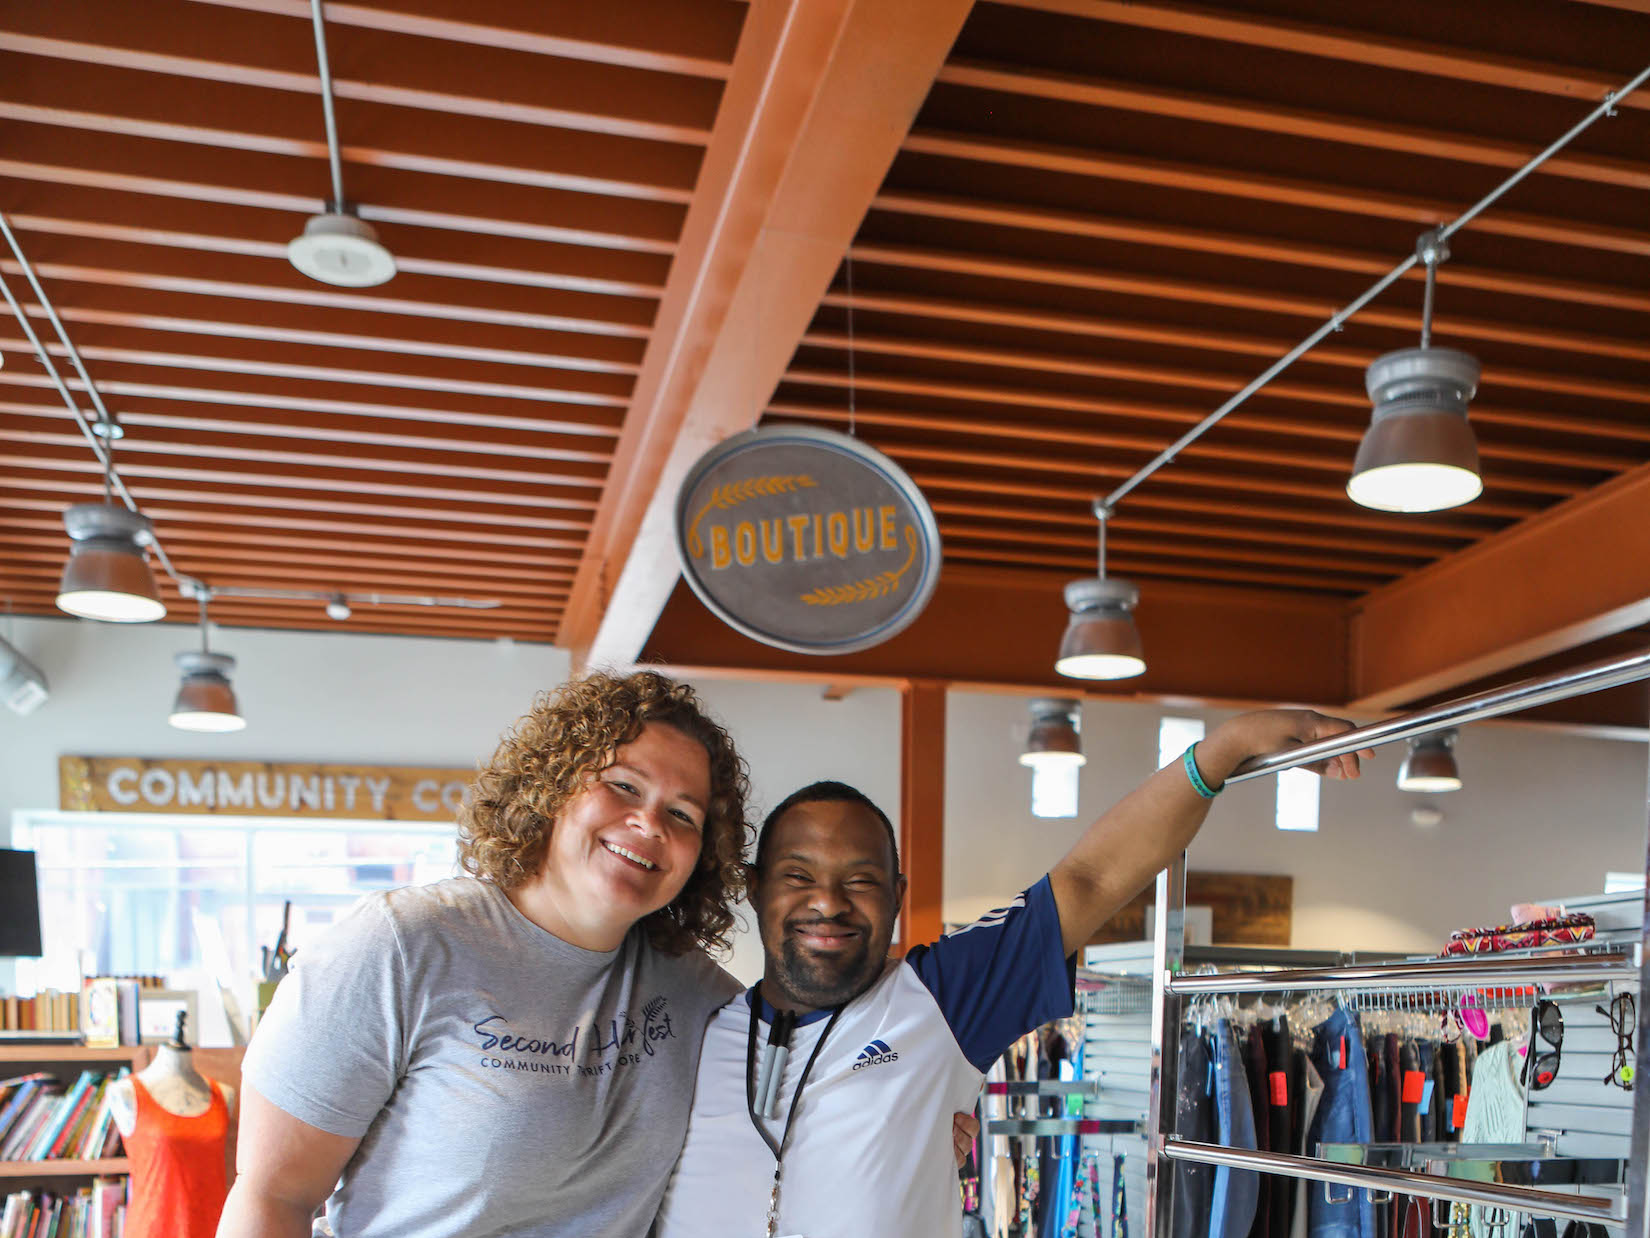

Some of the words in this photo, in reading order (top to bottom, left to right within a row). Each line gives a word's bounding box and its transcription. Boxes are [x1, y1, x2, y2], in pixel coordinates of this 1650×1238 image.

[709, 505, 898, 570] BOUTIQUE
[107, 767, 391, 811] COMMUNITY
[474, 1015, 579, 1062] Second
[592, 997, 677, 1057] Hrvest
[481, 1058, 570, 1075] COMMUNITY
[618, 1053, 641, 1066] ORE
[852, 1052, 899, 1071] adidas
